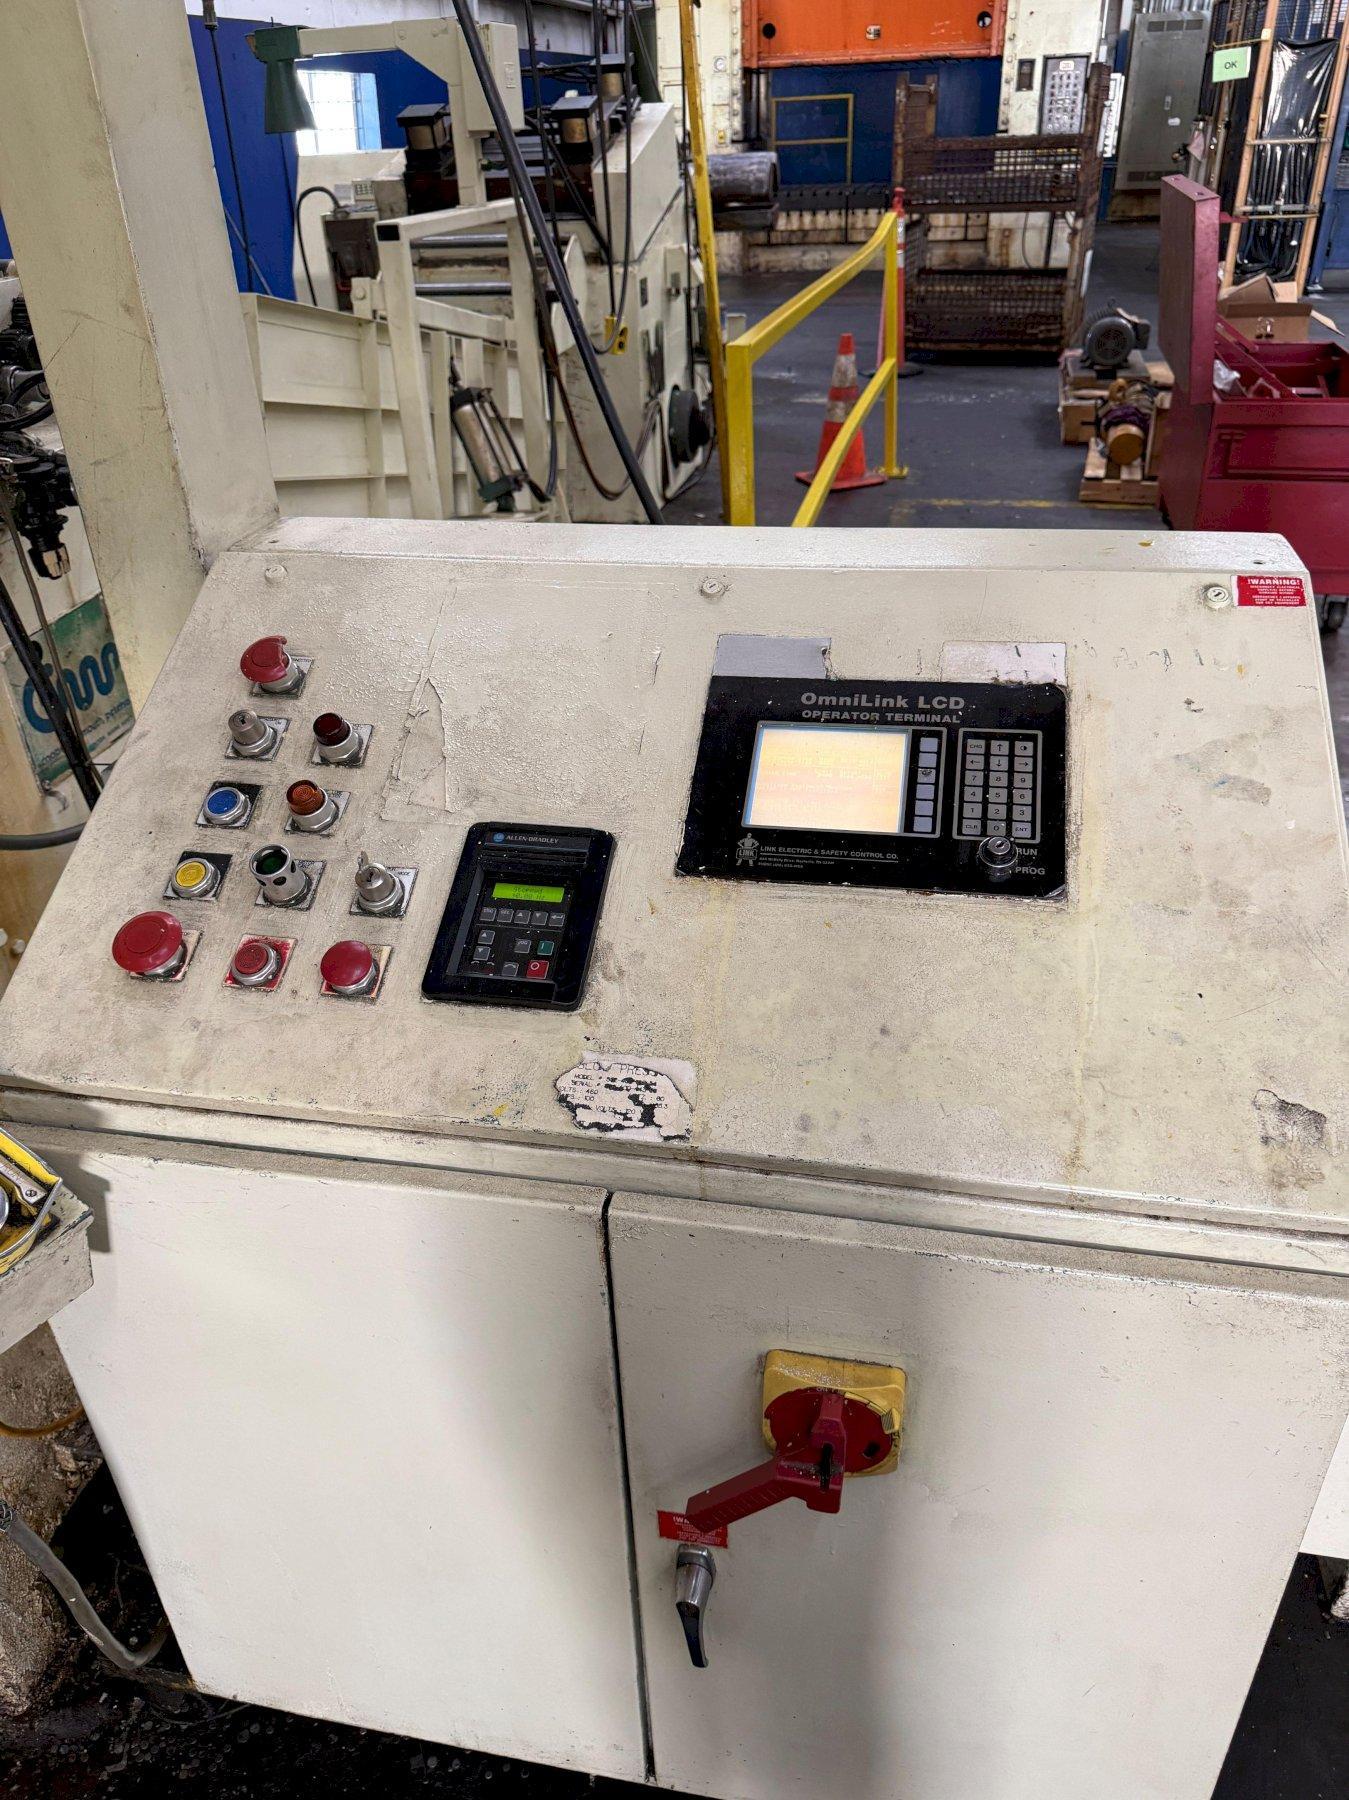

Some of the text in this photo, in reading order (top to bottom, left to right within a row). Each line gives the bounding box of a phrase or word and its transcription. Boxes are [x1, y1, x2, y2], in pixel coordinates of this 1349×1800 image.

[1224, 61, 1238, 70] OK
[801, 693, 965, 709] OmniLink LCD
[802, 710, 960, 723] OPERATOR TERMINAL
[506, 835, 559, 844] ALLEN-BRADLEY
[778, 847, 812, 855] ELECTRIC
[821, 849, 848, 857] SAFETY
[851, 851, 885, 859] CONTROL
[1017, 848, 1038, 856] RUN
[1015, 867, 1046, 875] PROG
